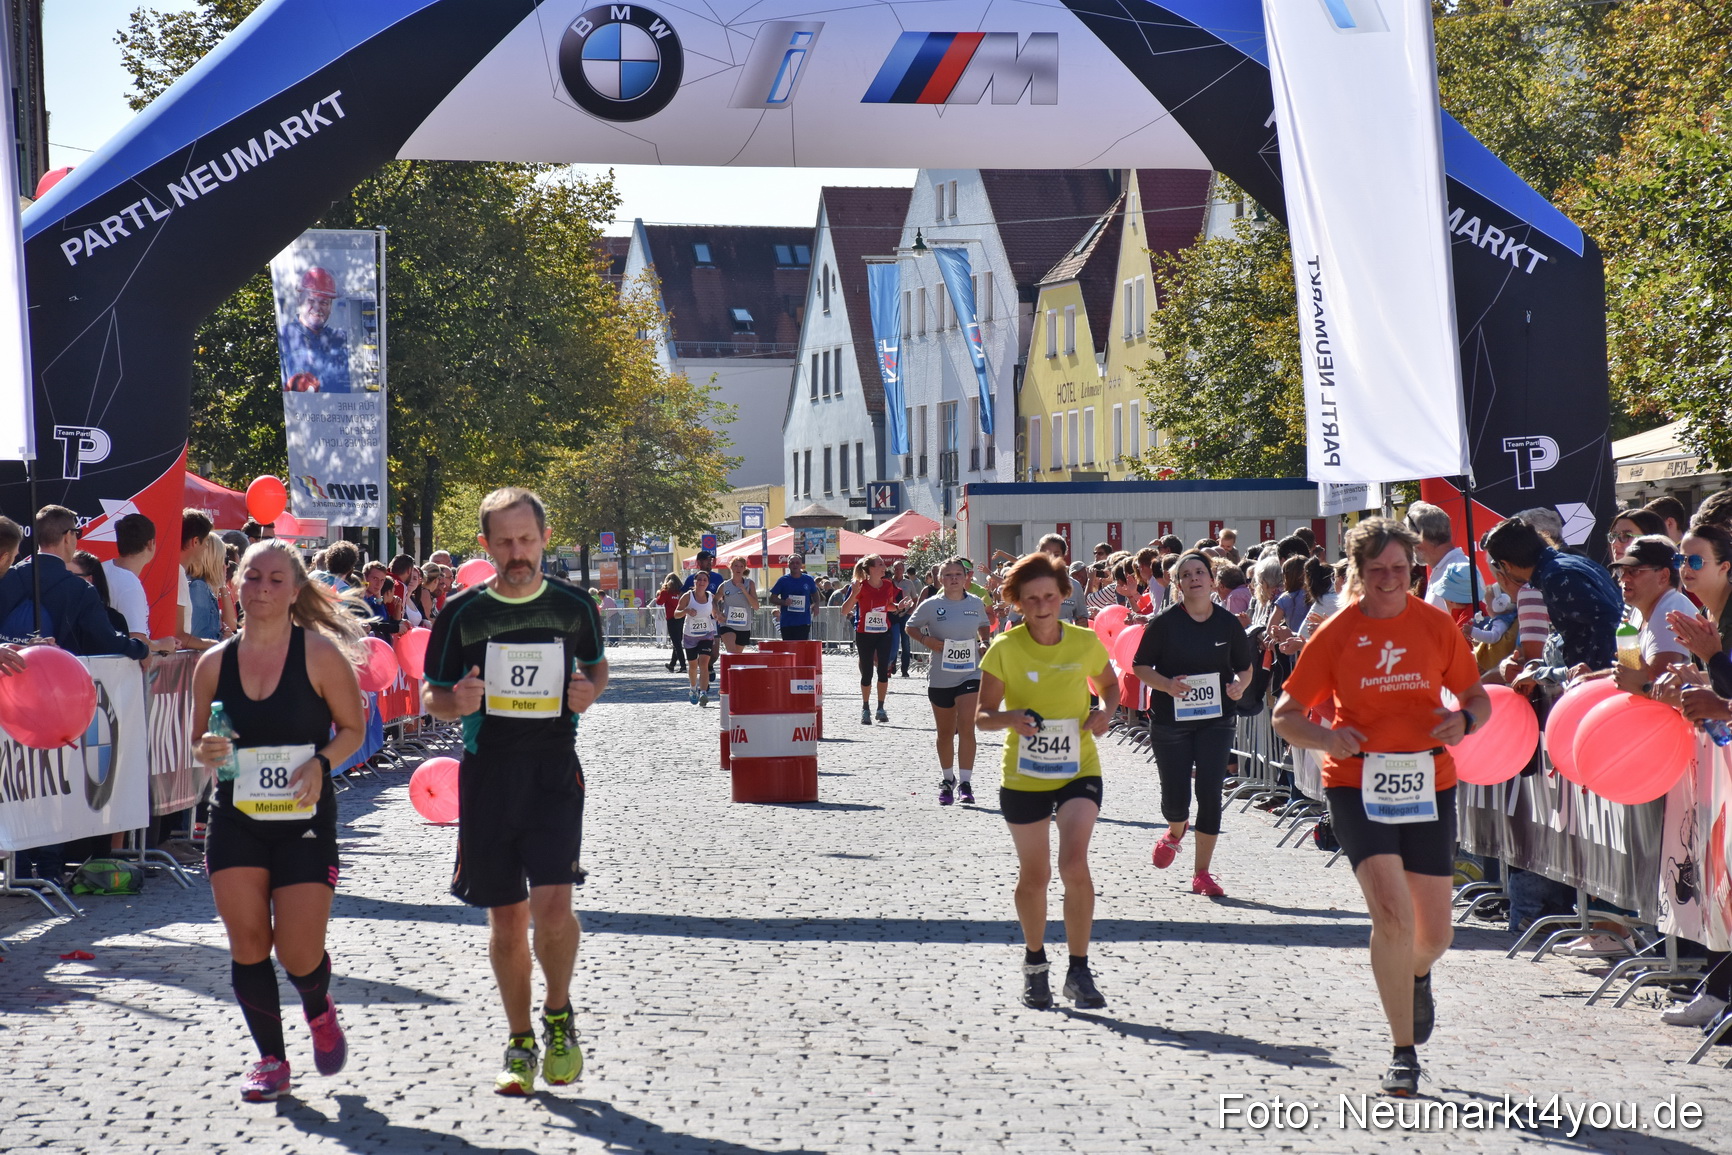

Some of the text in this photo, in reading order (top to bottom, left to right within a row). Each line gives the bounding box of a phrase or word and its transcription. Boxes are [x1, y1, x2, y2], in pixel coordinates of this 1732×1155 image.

[570, 4, 672, 40] BMW
[60, 89, 346, 266] PARTL NEUMARKT
[1056, 381, 1077, 405] HOTEL
[57, 429, 75, 437] Team
[1507, 440, 1524, 448] Team
[730, 611, 745, 619] 2340
[692, 622, 707, 630] 2213
[947, 648, 971, 660] 2069
[510, 665, 539, 687] 87
[1360, 672, 1421, 690] funrunners
[1379, 680, 1430, 693] neumarkt
[512, 700, 537, 710] Peter
[1027, 735, 1071, 754] 2544
[1033, 762, 1063, 772] Gerlinde
[259, 766, 288, 789] 88
[1373, 771, 1425, 794] 2553
[255, 802, 293, 812] Melanie
[1378, 804, 1420, 816] Hildegard
